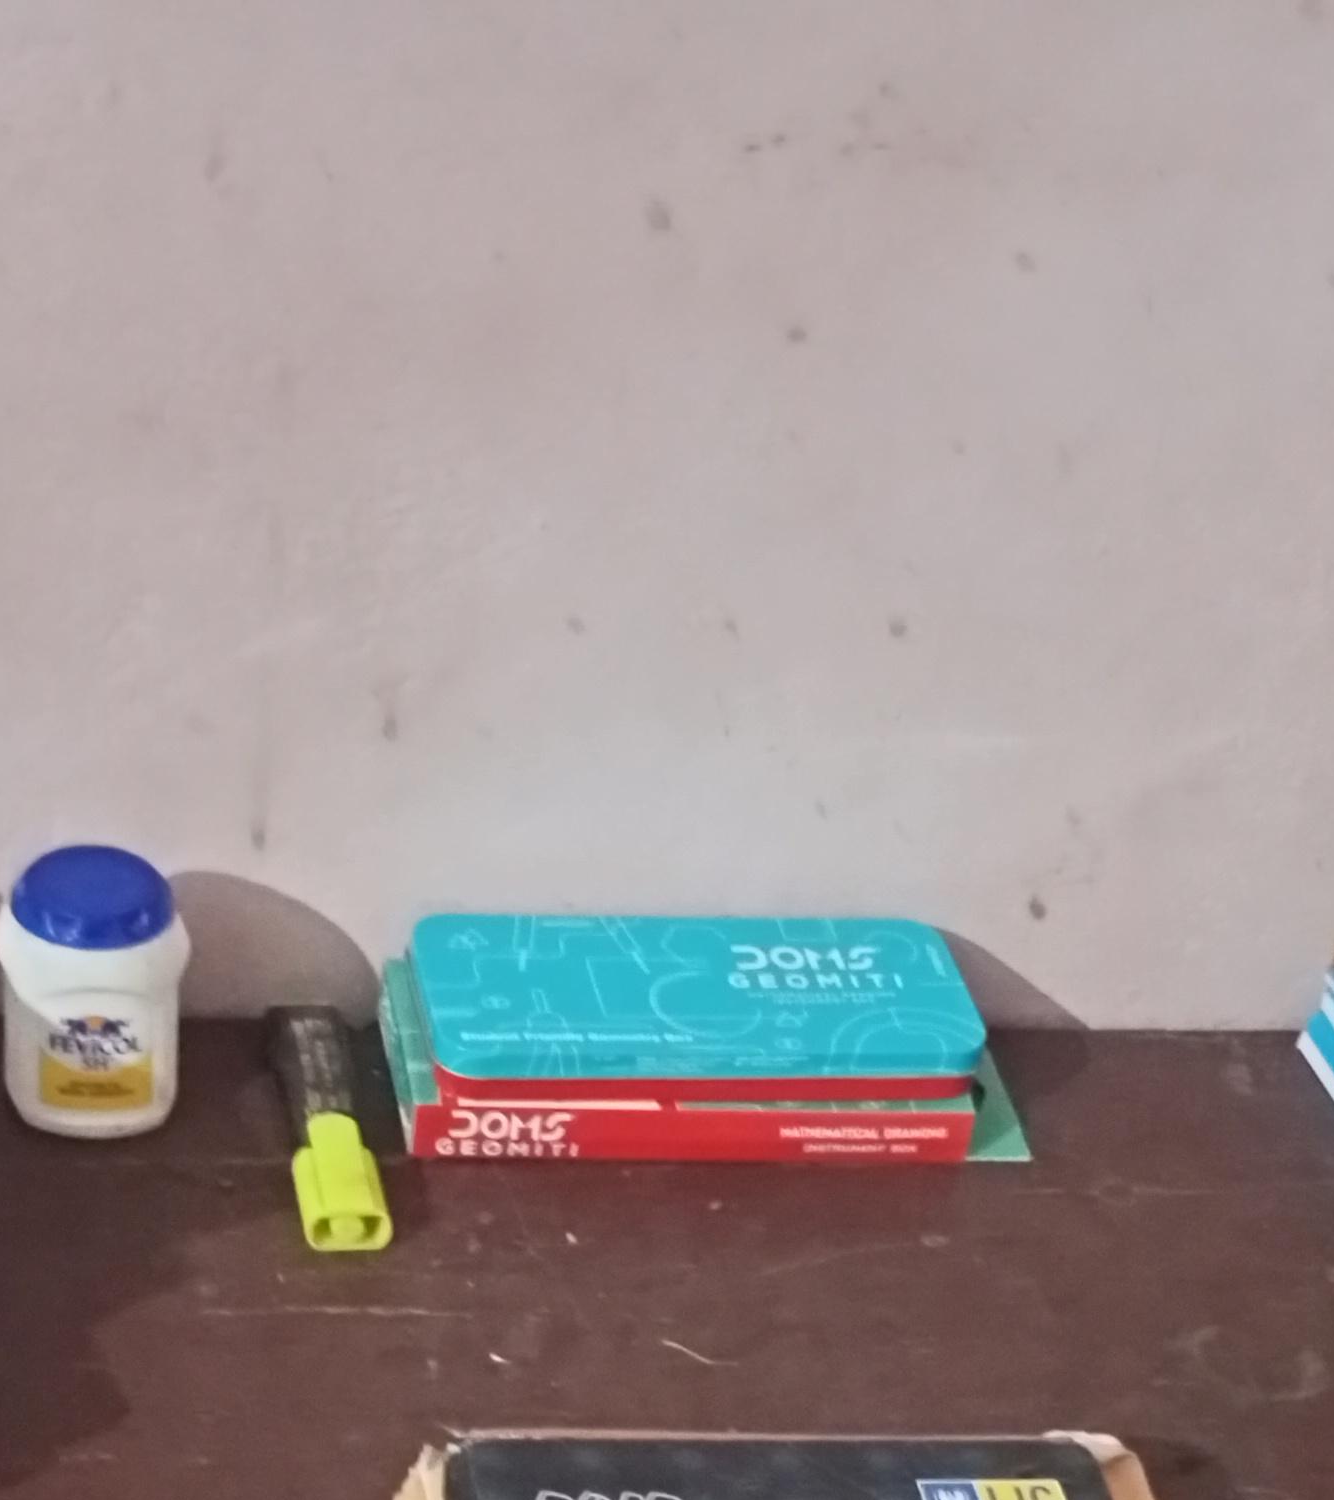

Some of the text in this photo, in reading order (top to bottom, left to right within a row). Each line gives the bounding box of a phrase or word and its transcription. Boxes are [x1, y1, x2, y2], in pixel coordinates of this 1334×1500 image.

[730, 943, 883, 972] DOMS
[727, 971, 905, 990] GEOMITI
[448, 1109, 576, 1142] DOMS
[435, 1137, 581, 1157] GEOMITI
